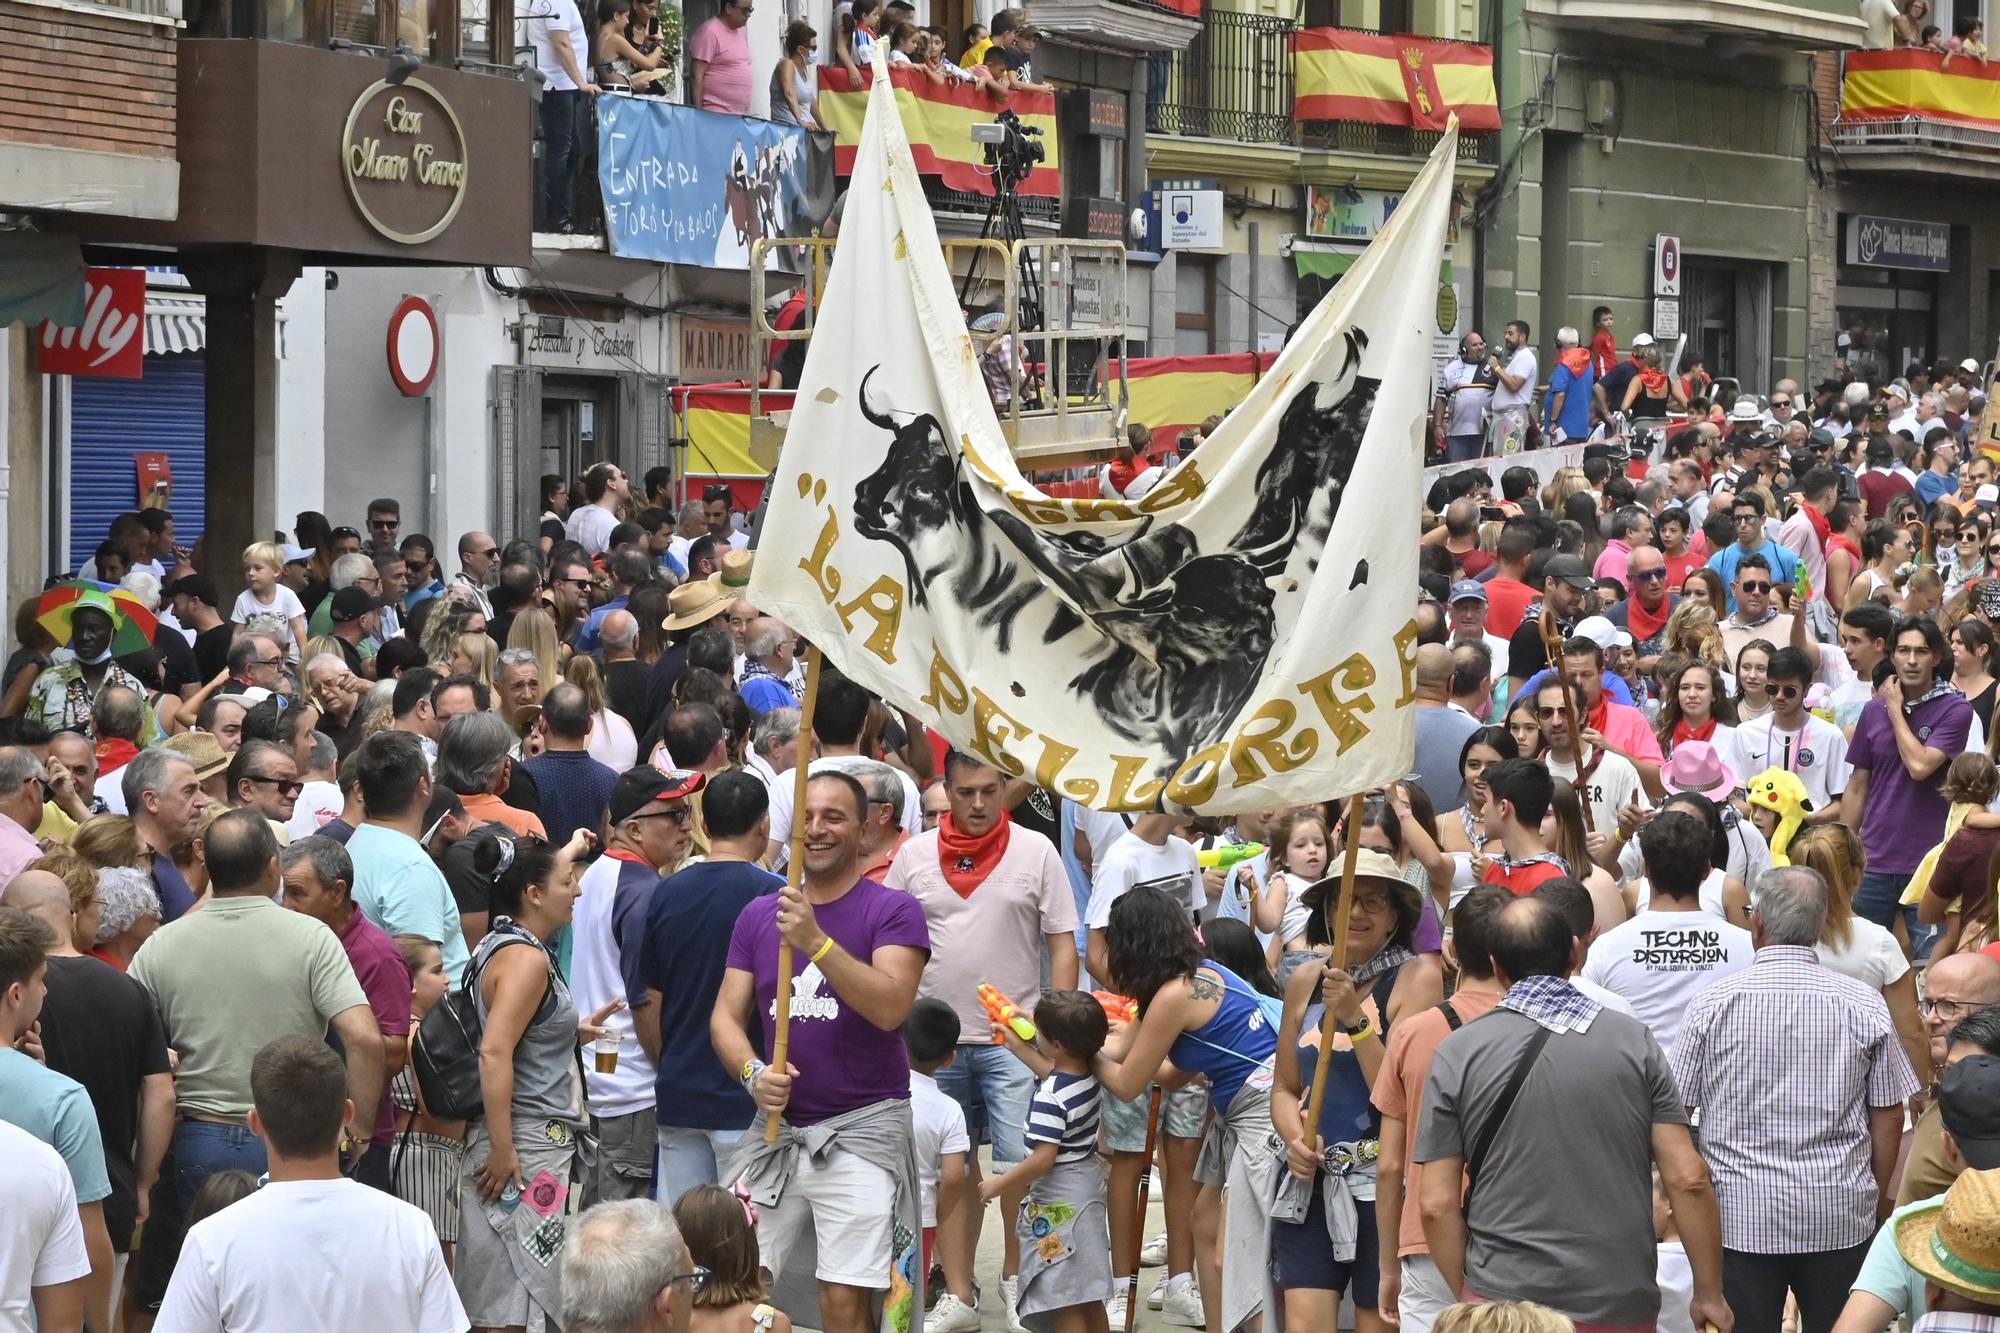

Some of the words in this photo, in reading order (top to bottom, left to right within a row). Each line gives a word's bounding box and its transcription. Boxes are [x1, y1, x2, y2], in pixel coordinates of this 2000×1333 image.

[385, 96, 423, 134] Casa
[1090, 102, 1125, 128] LOTERIA
[351, 137, 409, 182] Mauro
[413, 143, 463, 188] Torres
[610, 132, 699, 195] ENTRADA
[661, 207, 673, 241] Y
[685, 329, 768, 371] MANDARIA
[1633, 948, 1728, 965] DISTORSION
[1640, 930, 1719, 948] TECHNO
